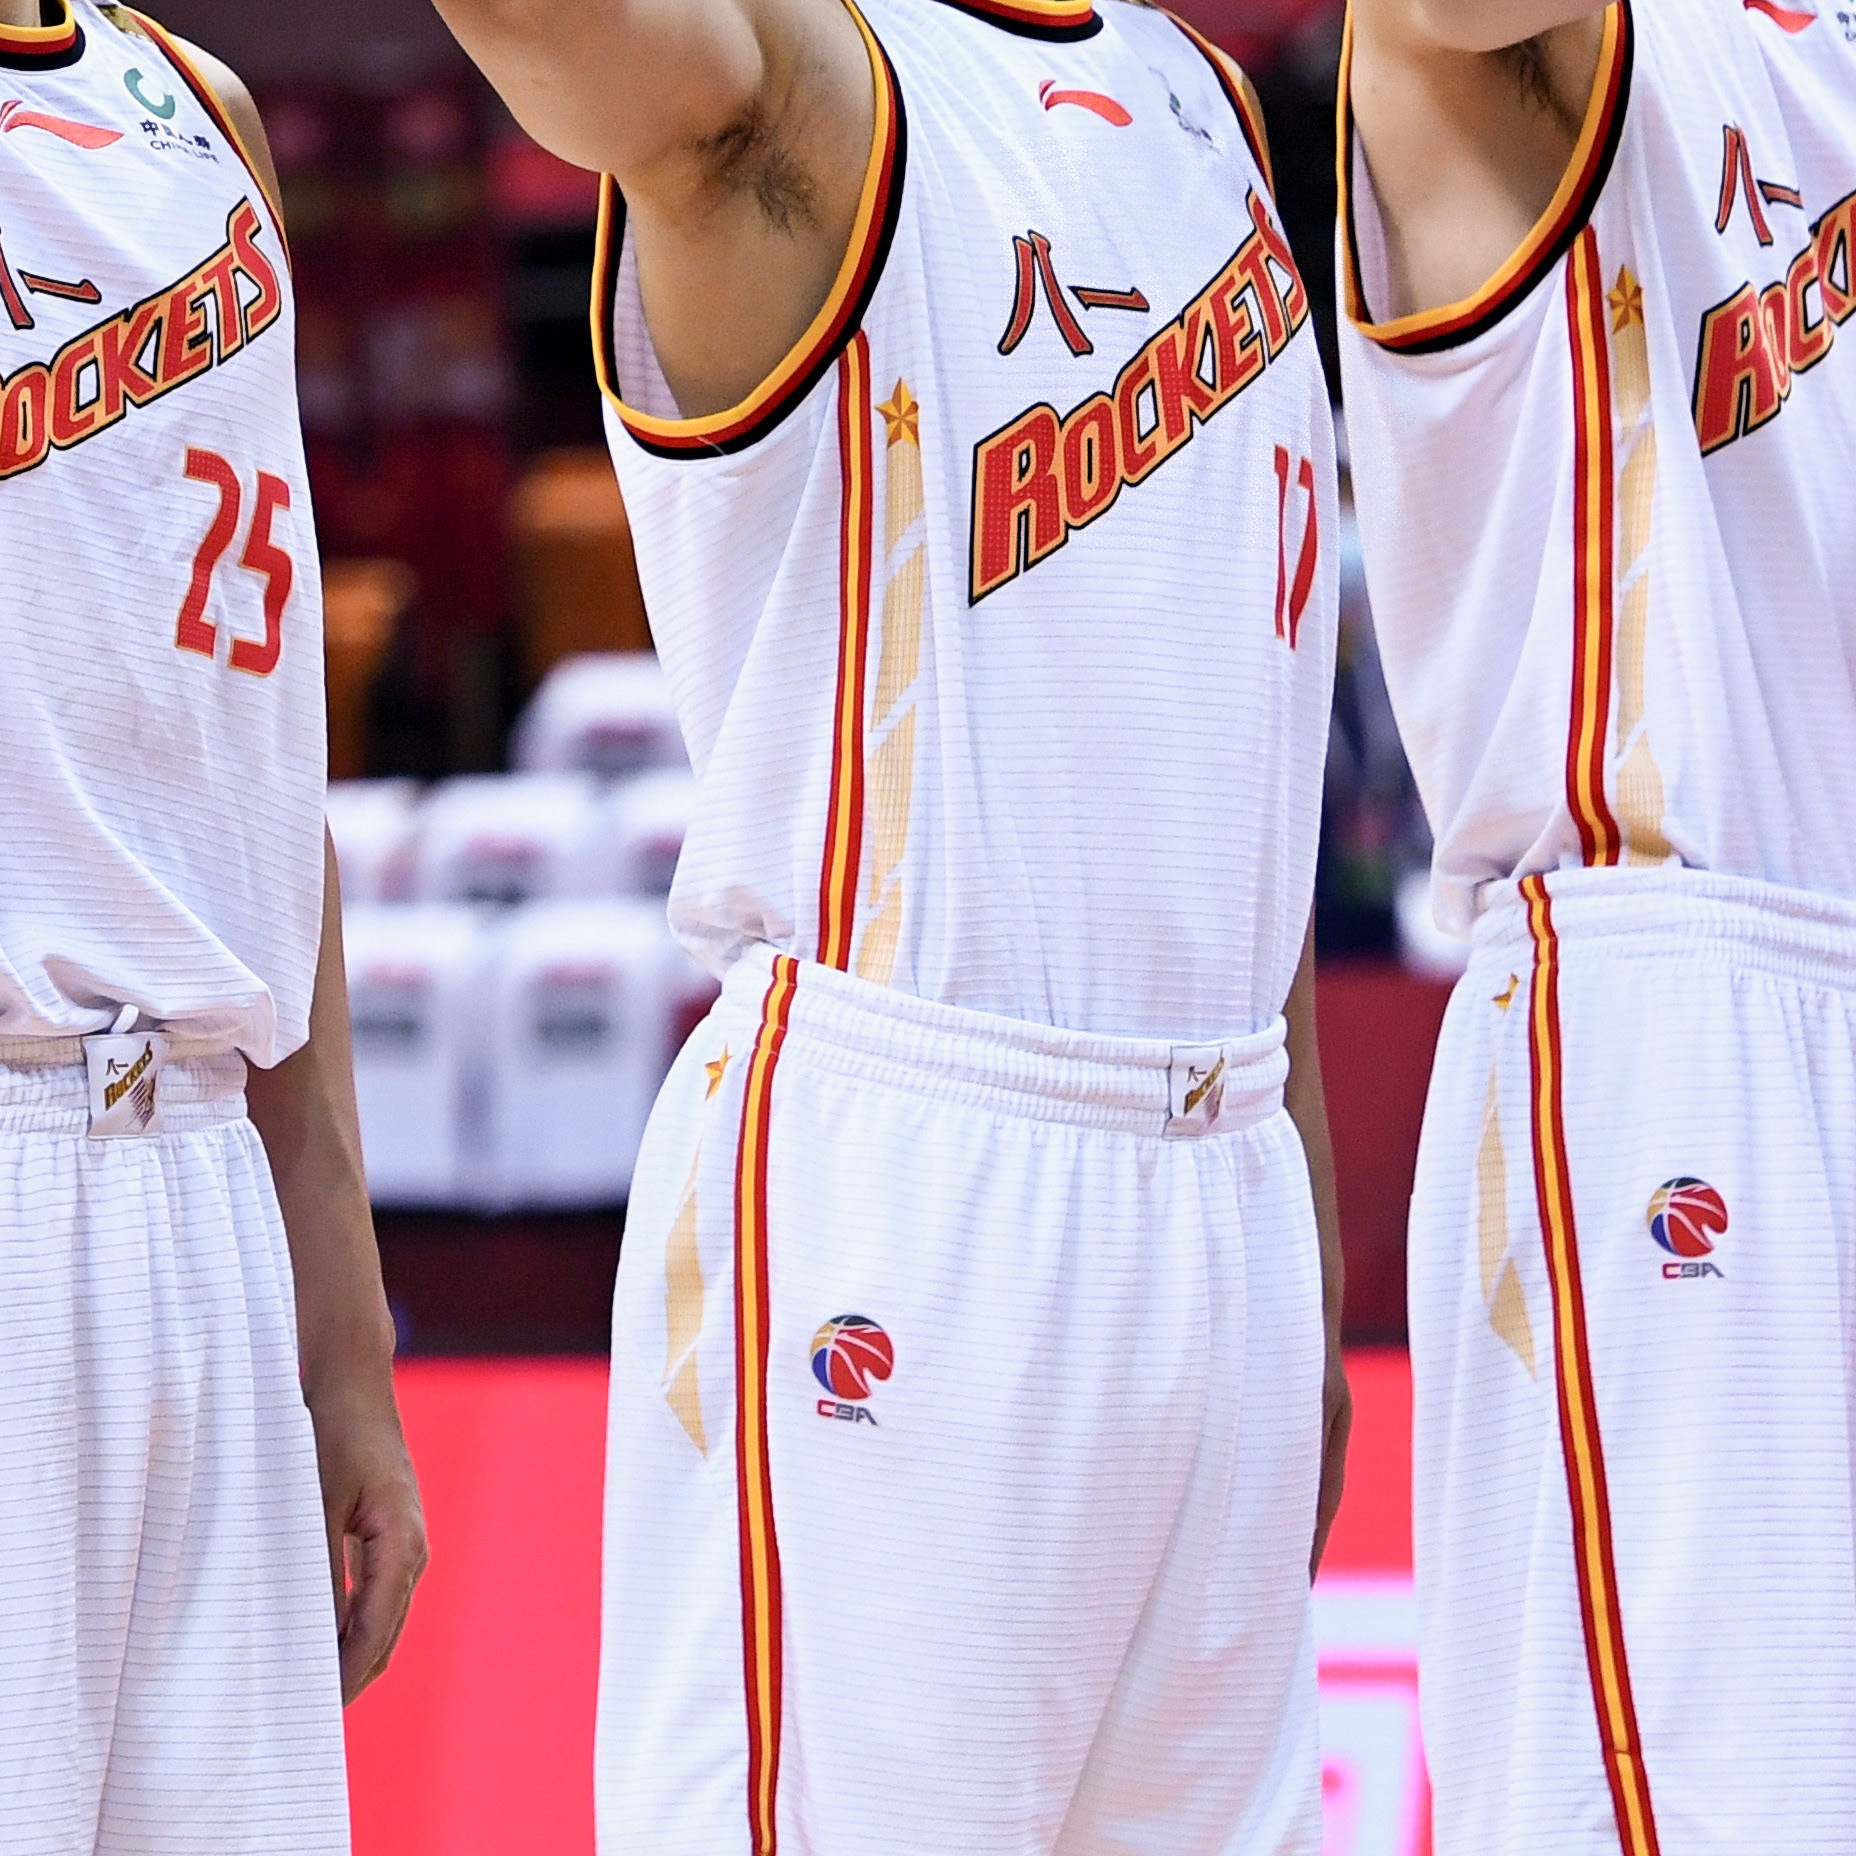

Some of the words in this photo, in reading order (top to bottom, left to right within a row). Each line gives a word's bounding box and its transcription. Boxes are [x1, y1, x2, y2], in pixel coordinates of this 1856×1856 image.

[1711, 122, 1803, 246] 八一
[998, 230, 1150, 356] 八一
[969, 184, 1312, 608] ROCKETS
[175, 445, 294, 679] 25
[1274, 444, 1319, 652] 17
[105, 1057, 130, 1076] 八一
[1661, 1262, 1726, 1280] CBA
[816, 1399, 879, 1427] CBA
